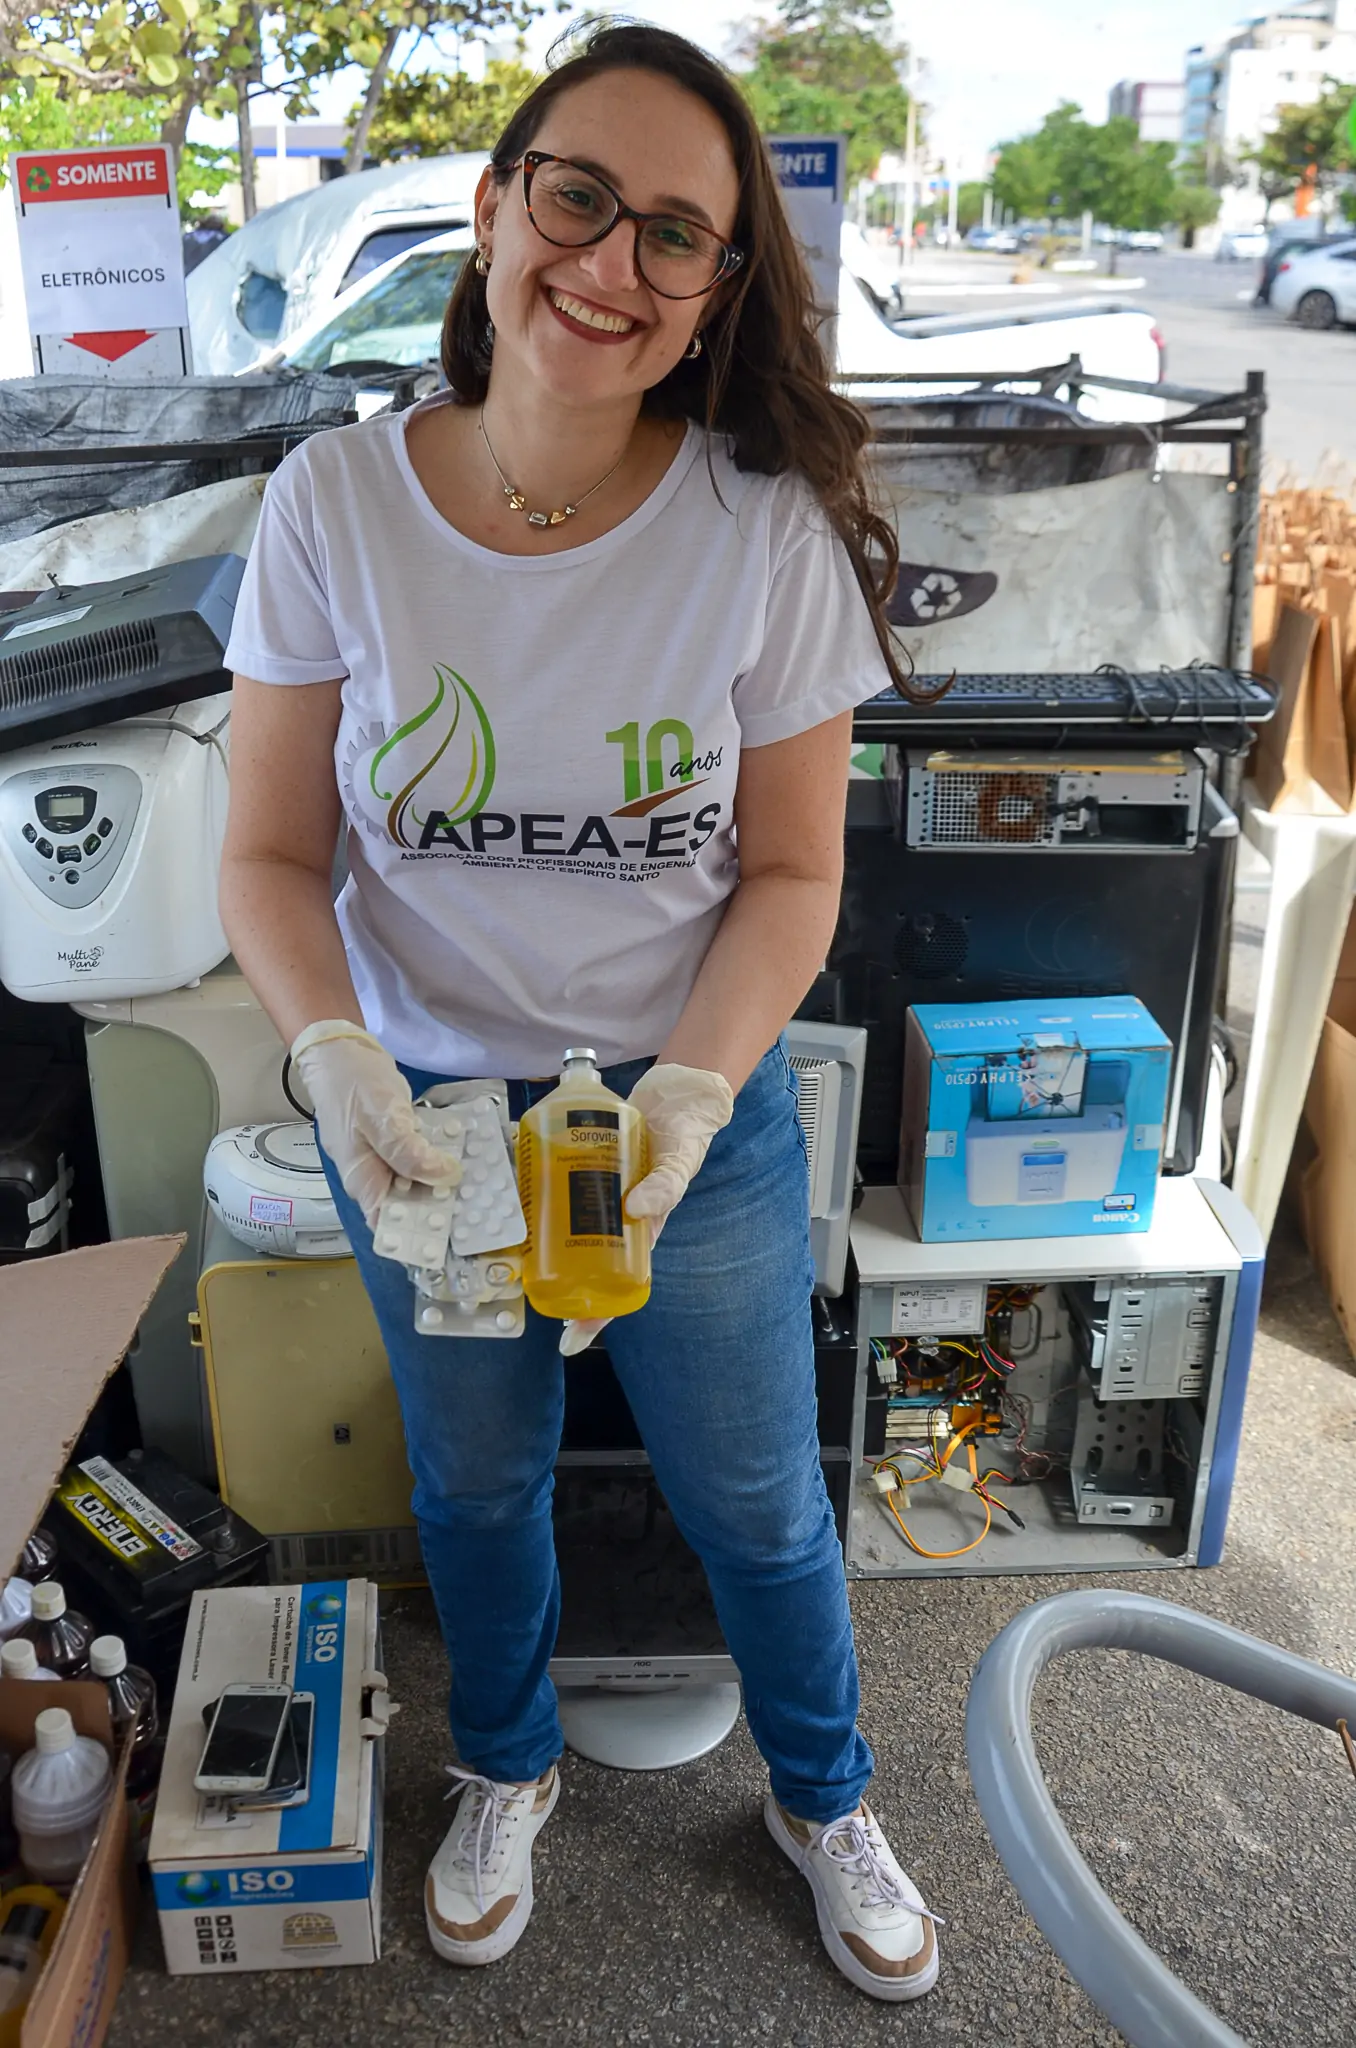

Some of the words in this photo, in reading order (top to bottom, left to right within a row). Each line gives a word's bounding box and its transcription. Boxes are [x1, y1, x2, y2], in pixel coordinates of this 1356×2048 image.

[57, 161, 157, 186] SOMENTE
[41, 267, 165, 288] ELETRÔNICOS
[605, 718, 694, 803] 10
[669, 746, 723, 779] anos
[417, 802, 721, 859] APEA-ES
[400, 852, 484, 861] ASSOCIAÇÃO
[487, 855, 514, 863] DOS
[518, 857, 616, 870] PROFISSIONAIS
[620, 862, 637, 872] DE
[462, 859, 534, 870] AMBIENTAL
[559, 866, 616, 880] ESPÍRITO
[619, 871, 660, 883] SANTO
[57, 949, 91, 961] Multi
[69, 960, 100, 969] Pane
[945, 1072, 977, 1085] CP510
[571, 1128, 618, 1144] Sorovita
[1092, 1212, 1141, 1223] Canon
[66, 1491, 149, 1558] ENERGY
[274, 1597, 282, 1614] para
[286, 1597, 296, 1629] Cartucho
[270, 1615, 281, 1657] Impressora
[285, 1631, 293, 1641] de
[314, 1622, 338, 1662] ISO
[283, 1642, 292, 1664] Toner
[268, 1658, 277, 1680] Laser
[227, 1869, 295, 1893] ISO
